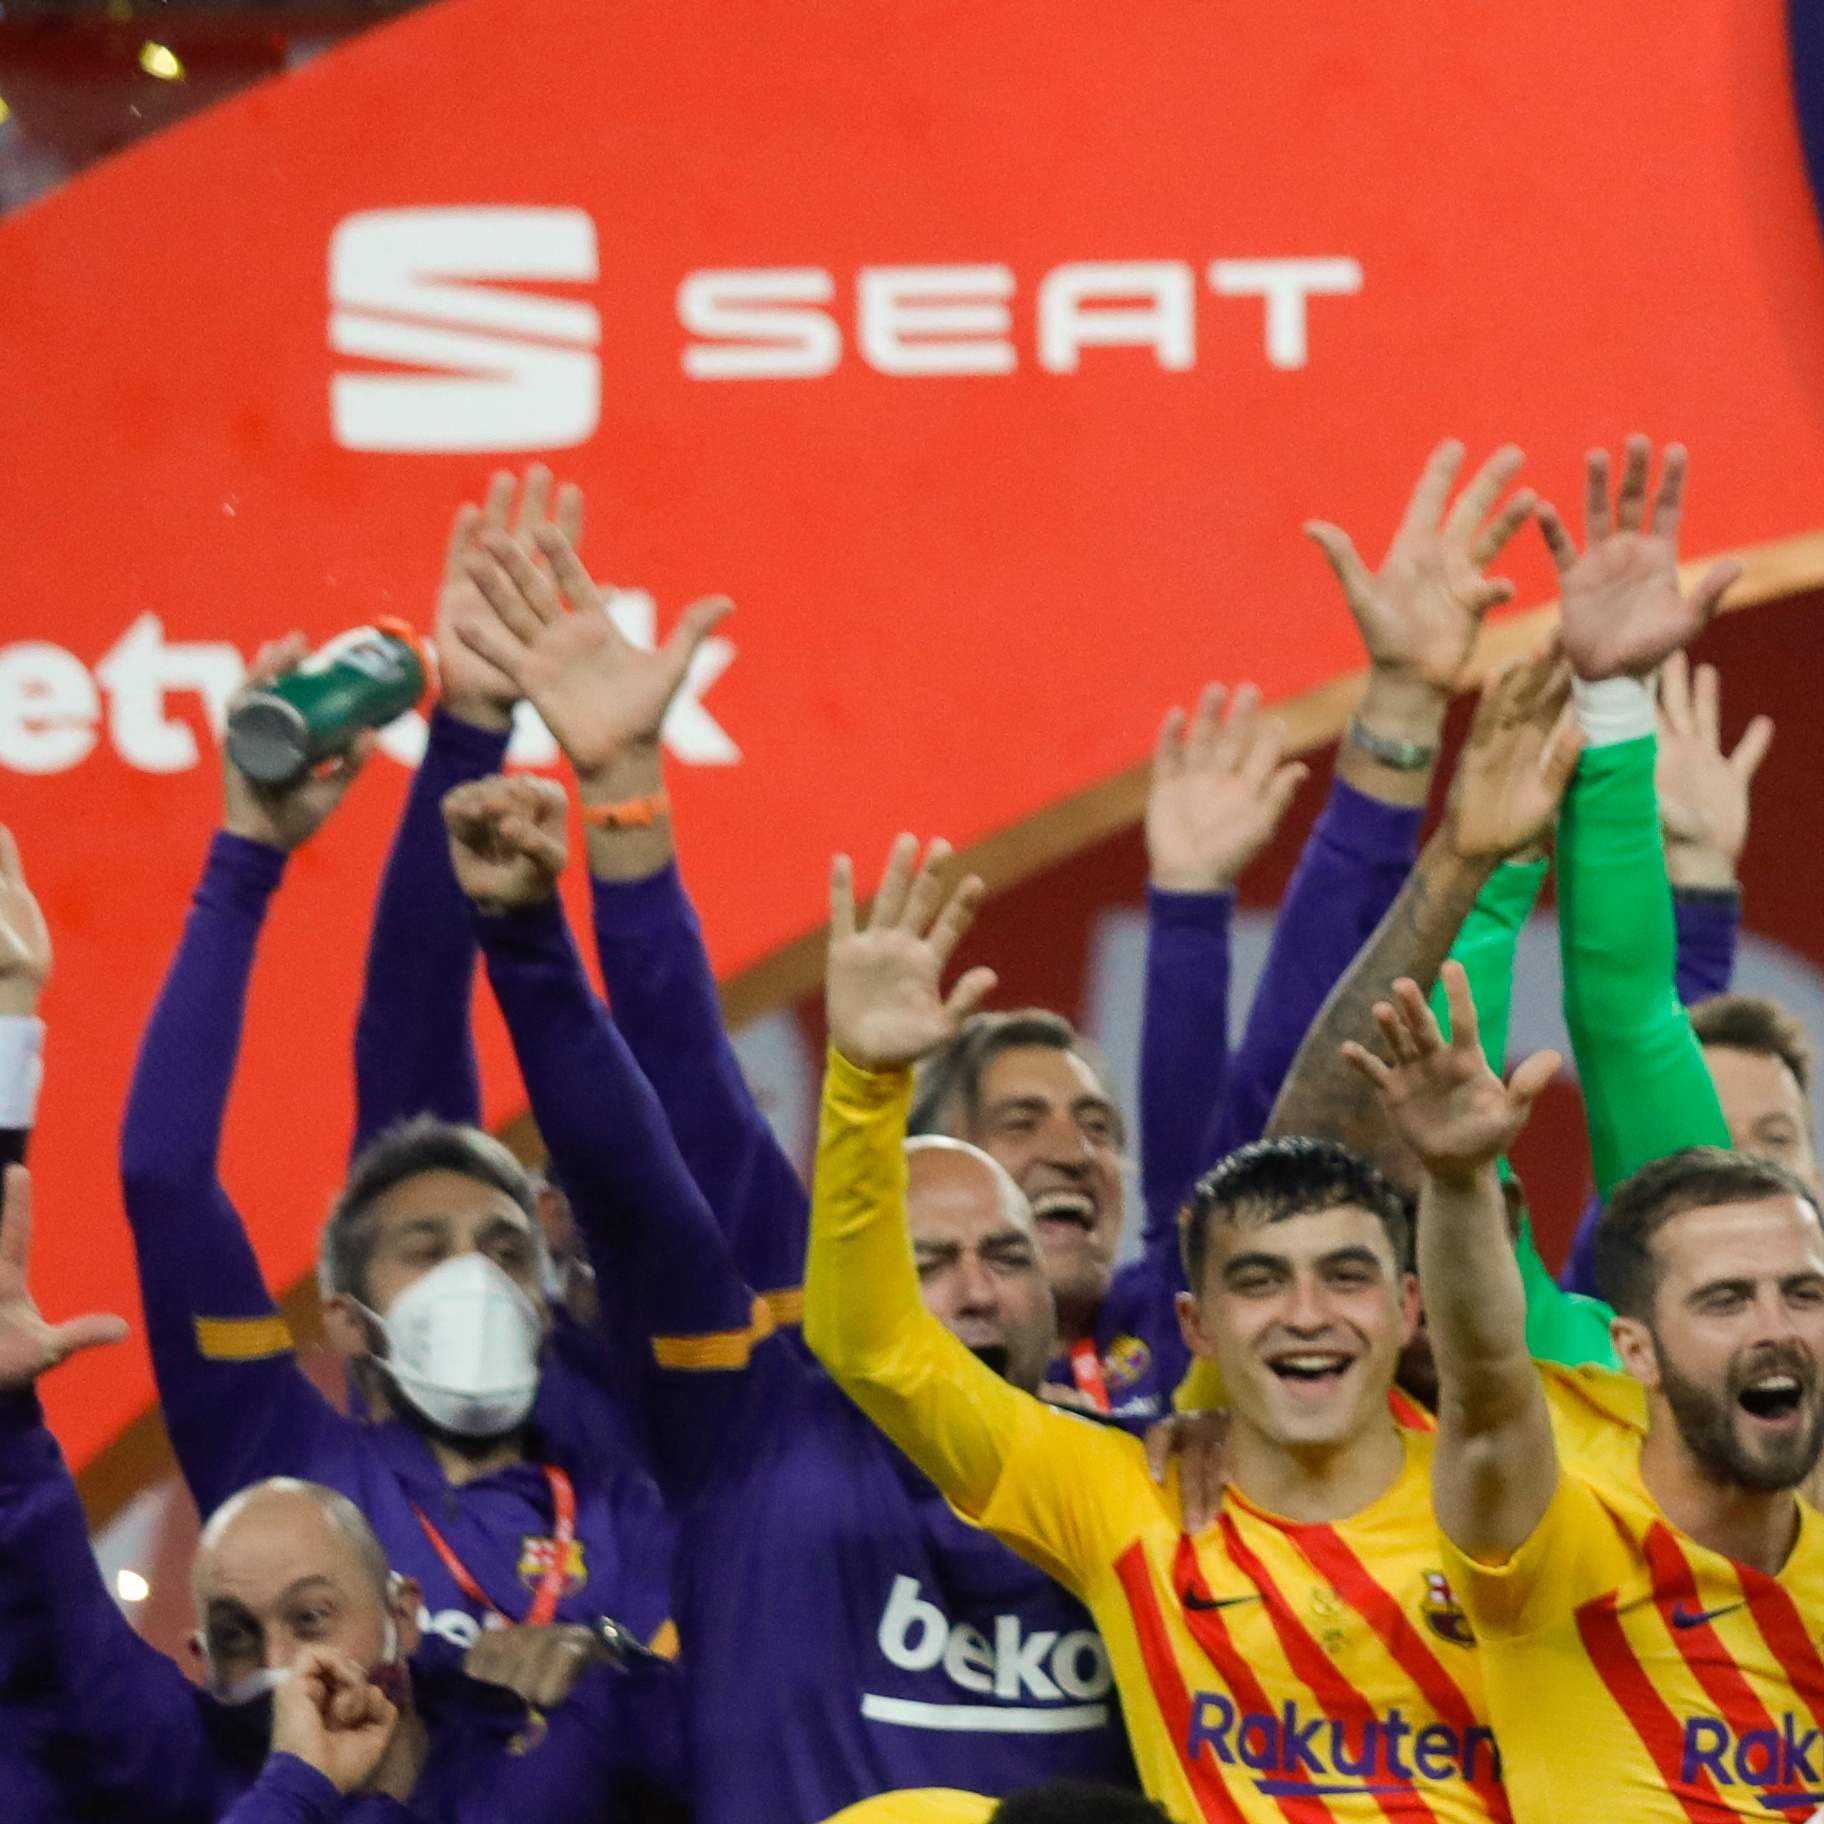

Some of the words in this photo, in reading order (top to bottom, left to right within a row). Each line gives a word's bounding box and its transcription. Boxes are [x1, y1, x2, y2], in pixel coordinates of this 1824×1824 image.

[676, 256, 1363, 382] SEAT
[878, 1573, 1112, 1701] beko
[1186, 1691, 1502, 1783] Rakuten
